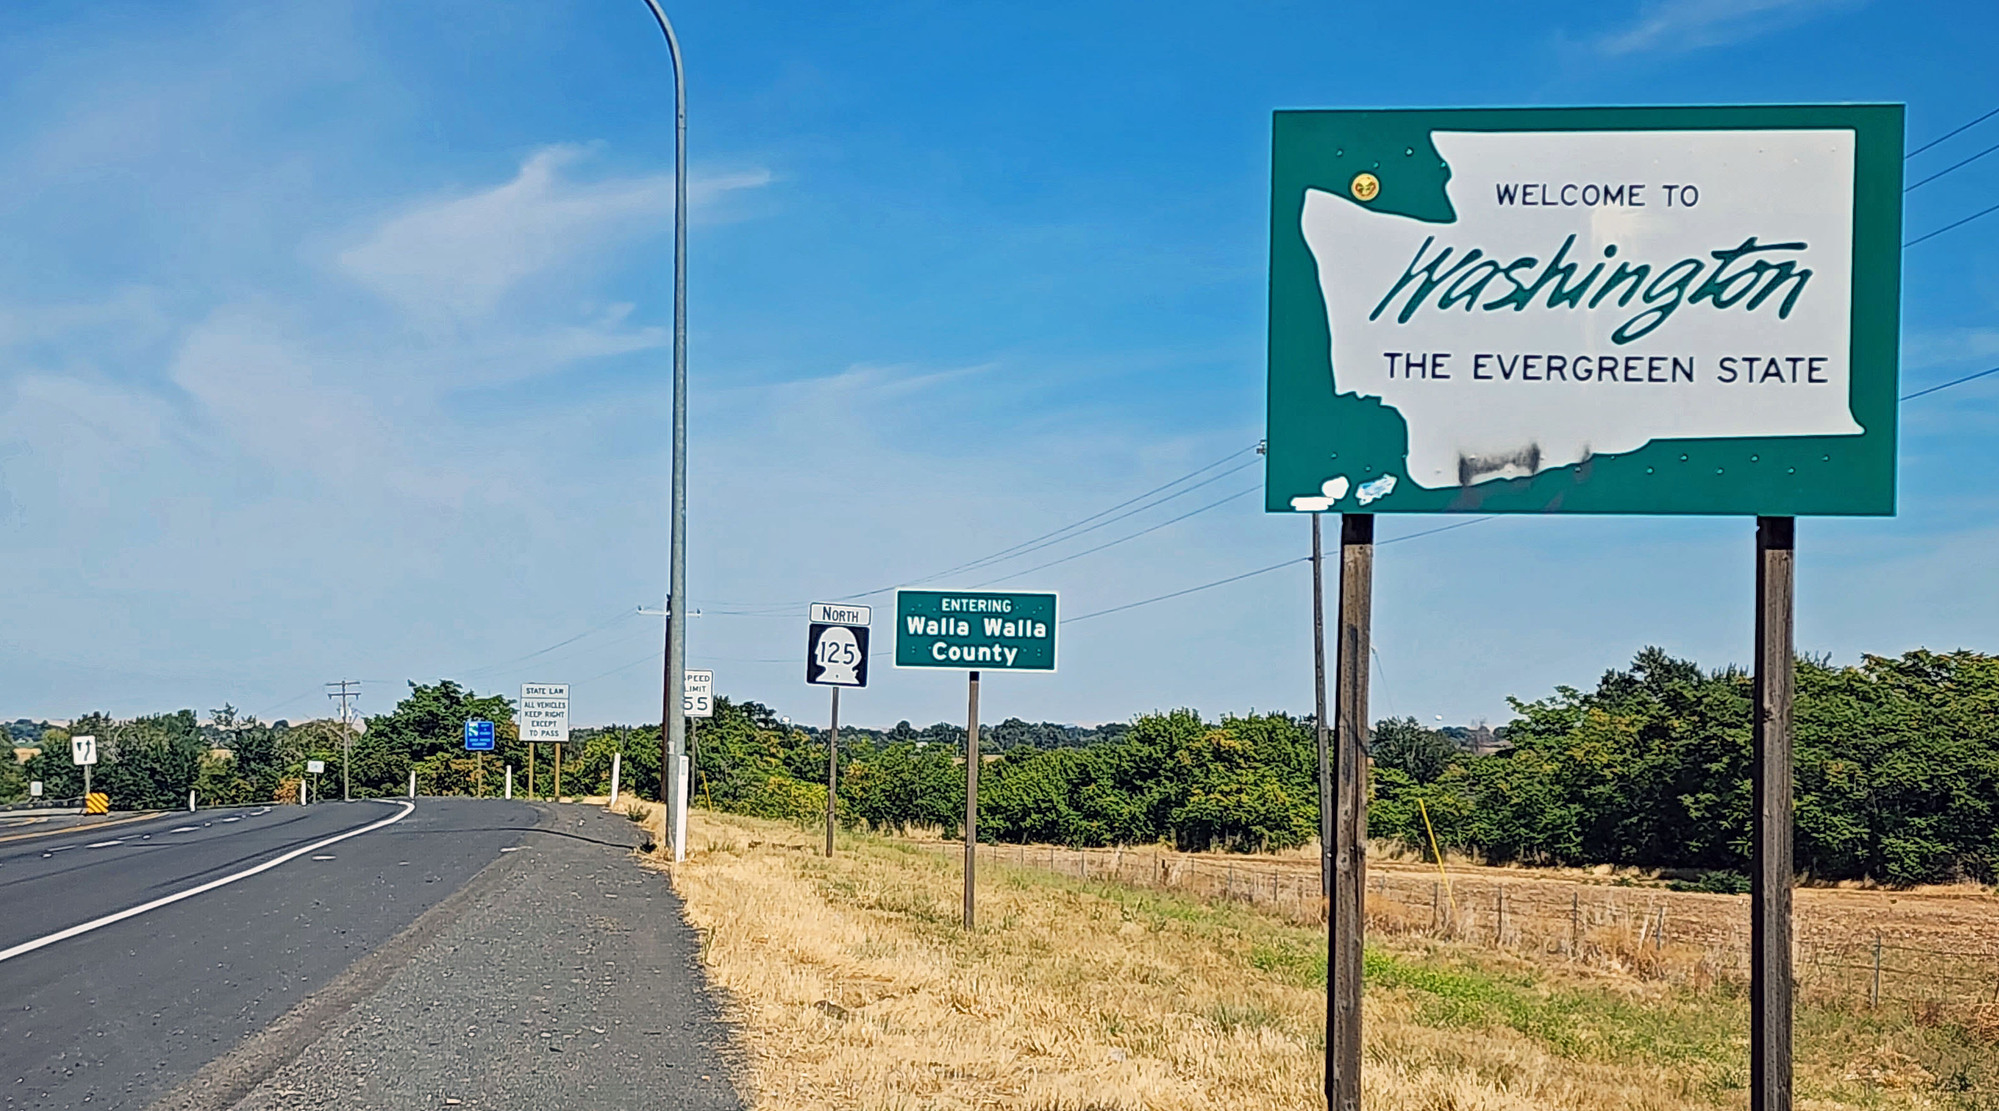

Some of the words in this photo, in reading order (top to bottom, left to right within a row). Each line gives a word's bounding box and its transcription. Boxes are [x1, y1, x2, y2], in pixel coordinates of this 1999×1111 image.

[1496, 184, 1646, 207] WELCOME
[1662, 184, 1700, 207] TO
[1369, 233, 1814, 345] Washington
[1383, 352, 1451, 379] THE
[1473, 354, 1695, 383] EVERGREEN
[1717, 356, 1829, 383] STATE
[941, 598, 1012, 613] ENTERING
[822, 606, 859, 623] NORTH
[906, 616, 970, 636] Walla
[983, 618, 1047, 638] Walla
[820, 641, 856, 665] 125
[932, 641, 1018, 667] County
[684, 674, 710, 682] PEED
[526, 687, 546, 695] STATE
[549, 687, 564, 695] LAW
[524, 701, 535, 709] ALL
[537, 701, 566, 709] VEHICLES
[683, 696, 708, 711] 55
[524, 710, 542, 718] KEEP
[529, 729, 538, 737] TO
[541, 729, 559, 737] PASS
